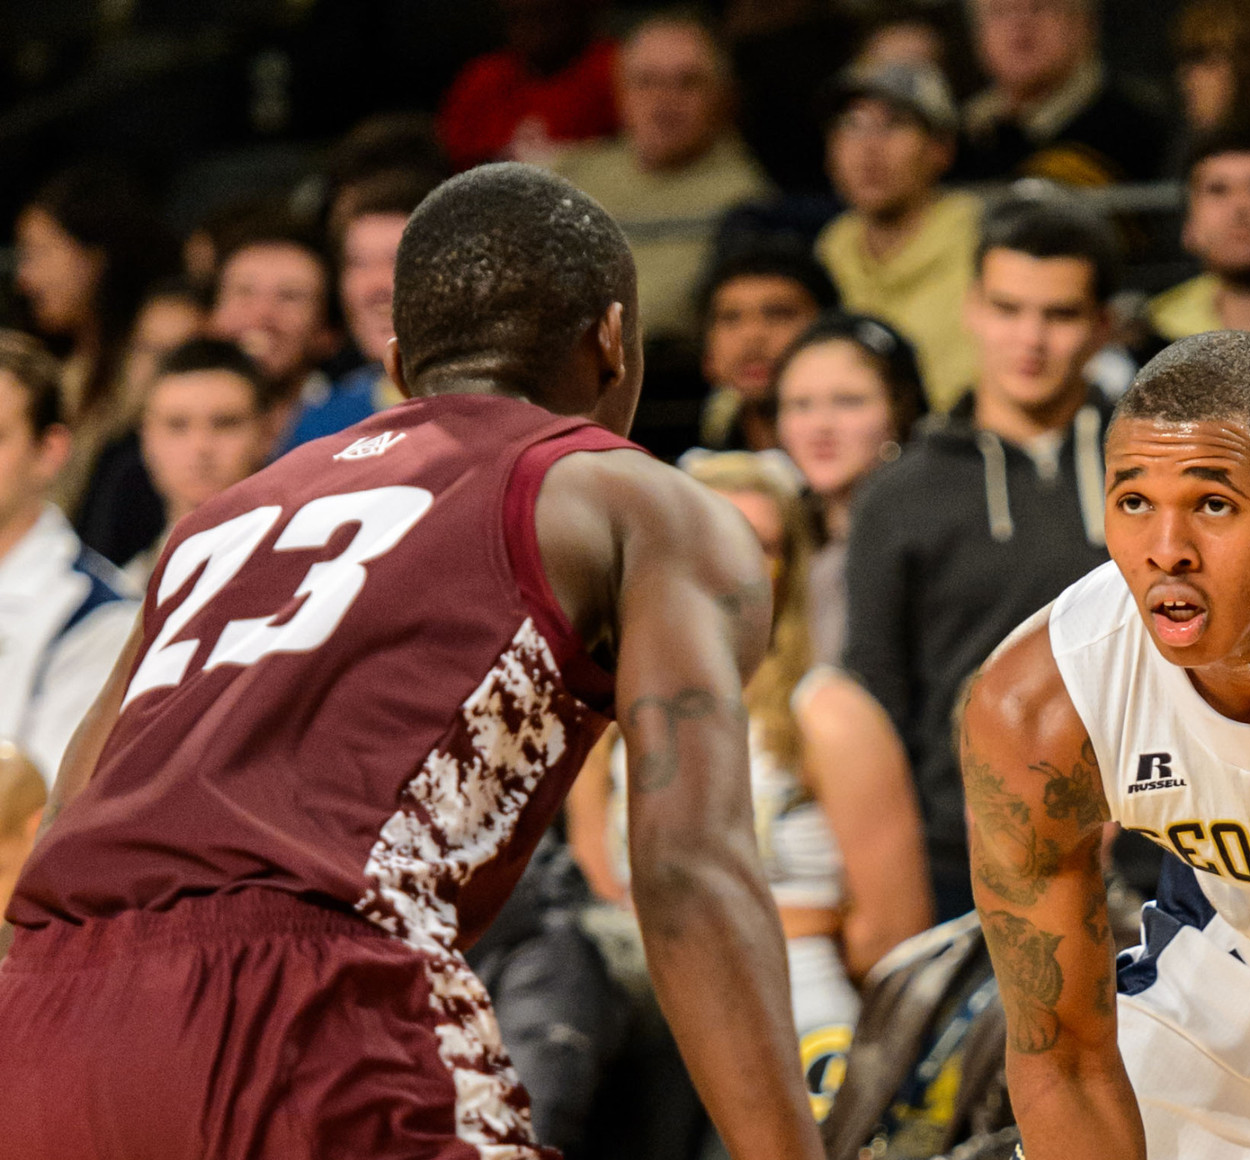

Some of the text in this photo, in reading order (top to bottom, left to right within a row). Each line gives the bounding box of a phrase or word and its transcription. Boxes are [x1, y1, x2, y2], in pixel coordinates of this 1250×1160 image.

[119, 485, 434, 715] 23
[1136, 752, 1172, 782] R
[1128, 779, 1187, 794] RUSSELL
